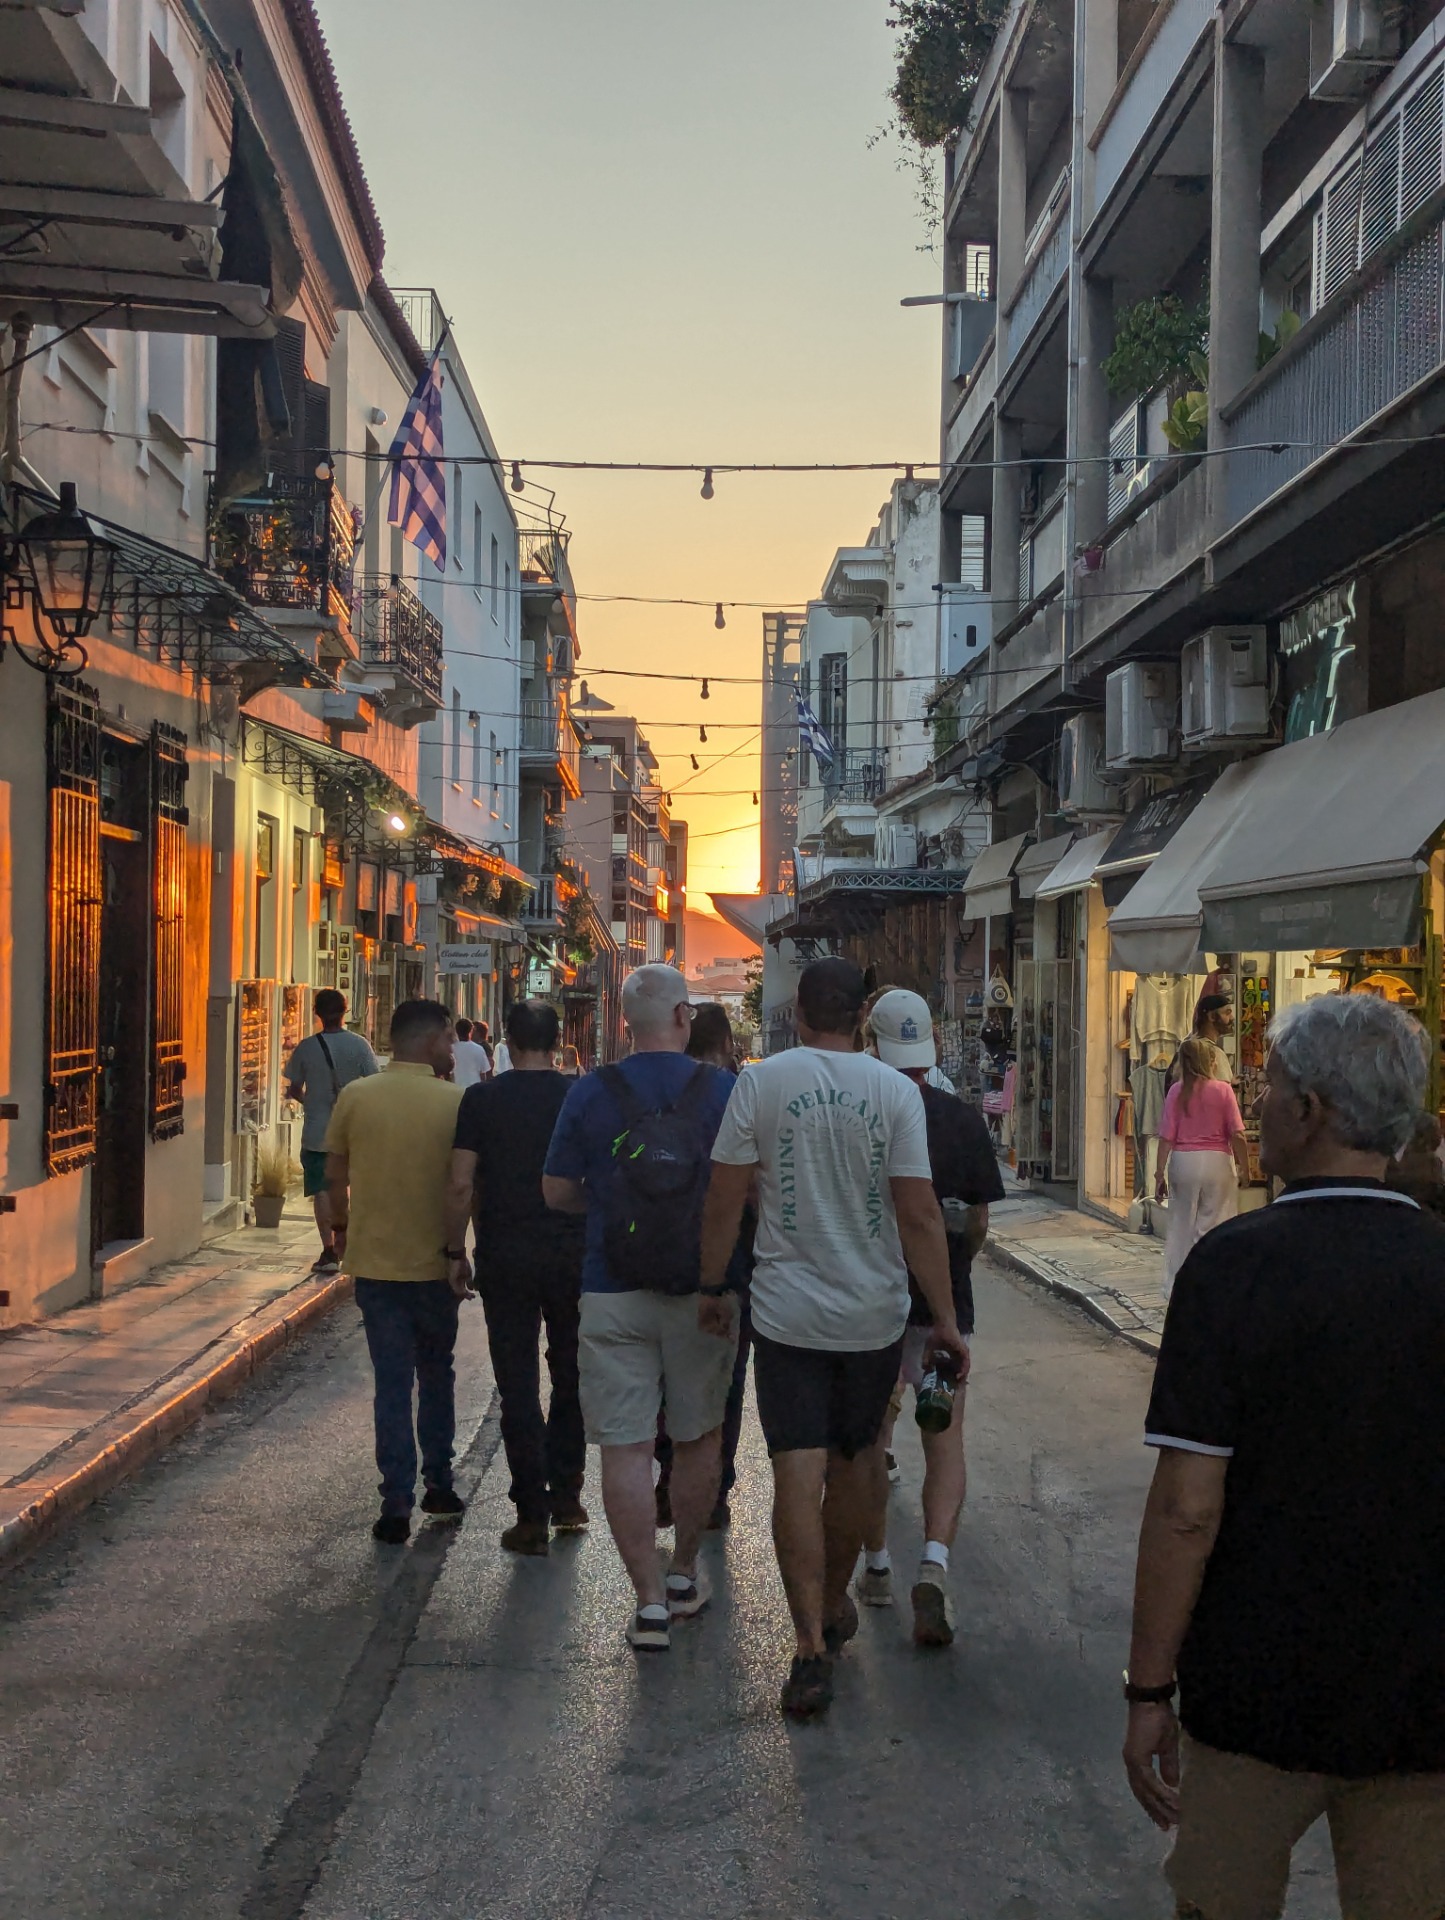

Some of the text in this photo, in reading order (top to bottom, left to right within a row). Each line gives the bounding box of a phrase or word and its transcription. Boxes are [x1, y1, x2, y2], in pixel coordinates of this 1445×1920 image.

[470, 949, 489, 958] club
[786, 1088, 884, 1131] PELICAN
[777, 1127, 797, 1233] PRAYING
